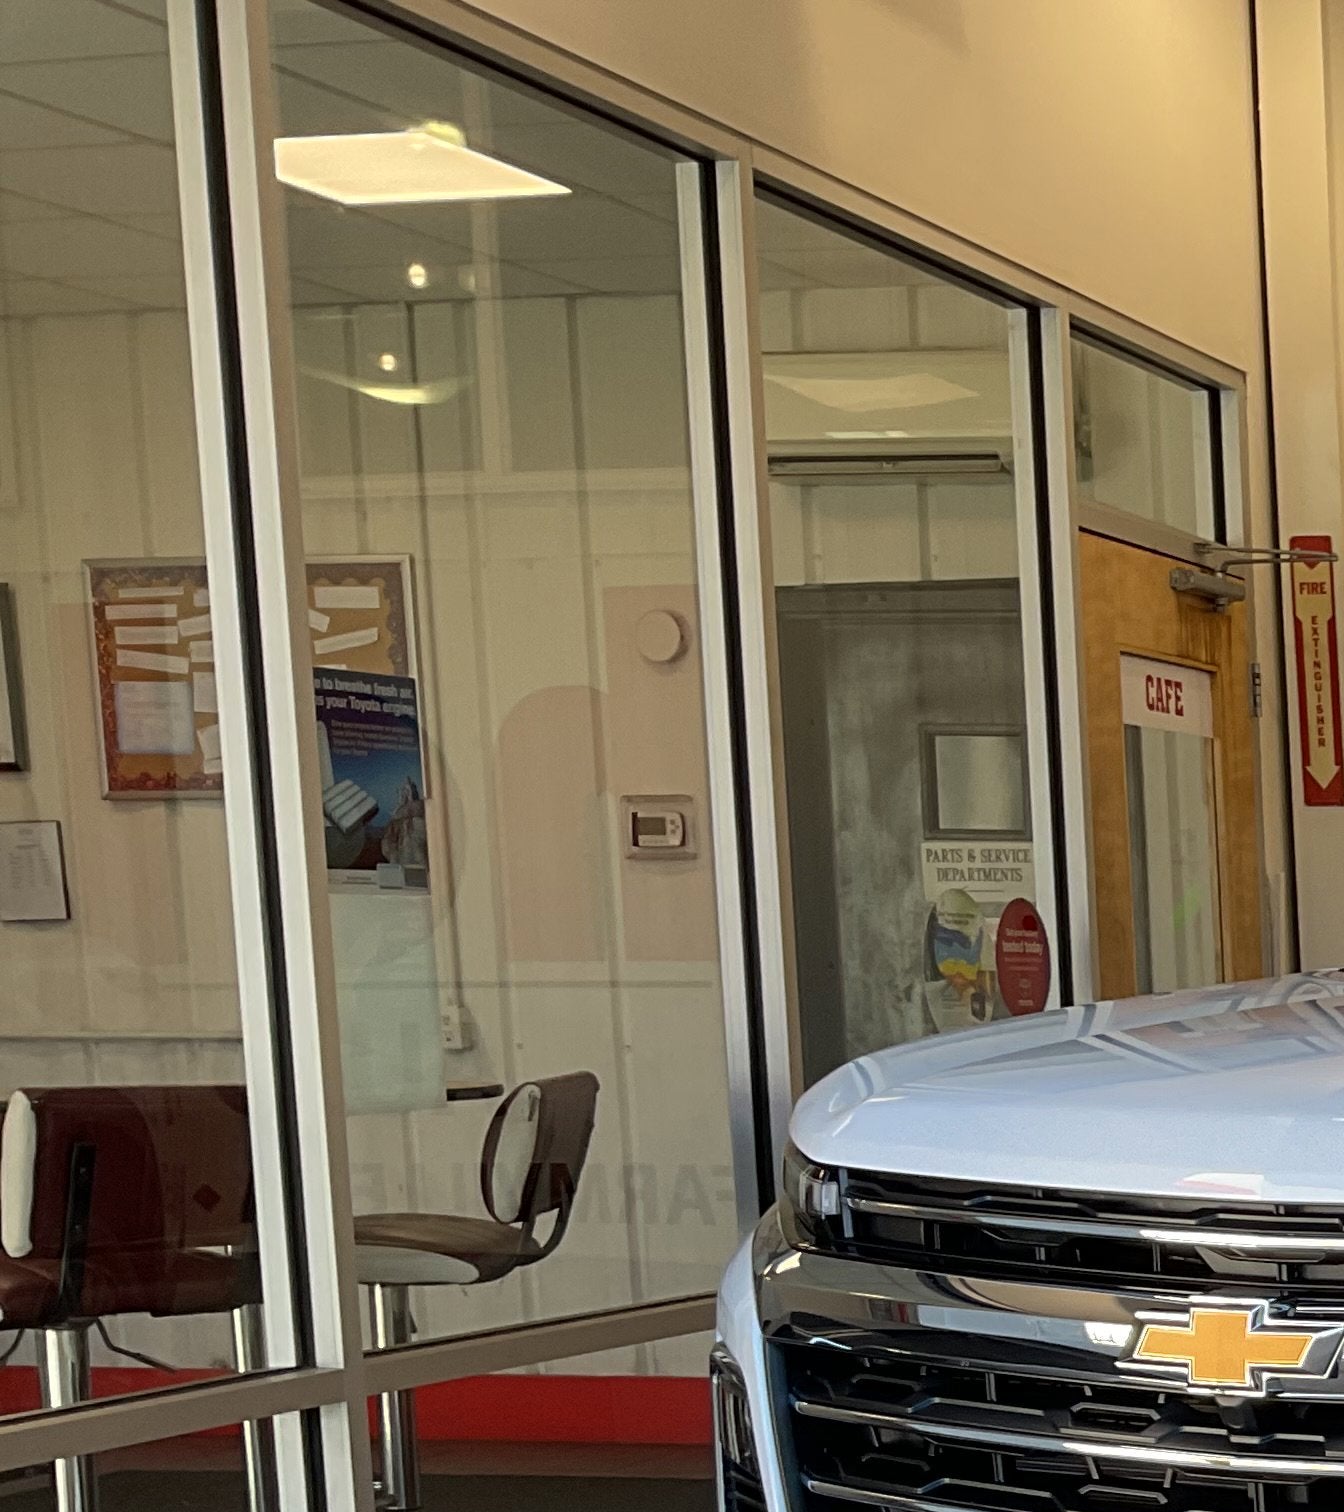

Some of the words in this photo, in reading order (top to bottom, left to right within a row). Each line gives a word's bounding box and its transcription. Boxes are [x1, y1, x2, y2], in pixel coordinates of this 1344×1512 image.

[1299, 581, 1326, 595] FIRE
[322, 677, 332, 689] to
[1310, 614, 1326, 747] EXTINGUISHER
[1145, 673, 1185, 717] CAFE
[325, 696, 346, 709] your
[348, 695, 381, 713] Toyota
[925, 848, 963, 863] PARTS
[967, 848, 976, 863] &
[980, 848, 1032, 863] SERVICE
[936, 867, 1023, 882] DEPARTMENTS
